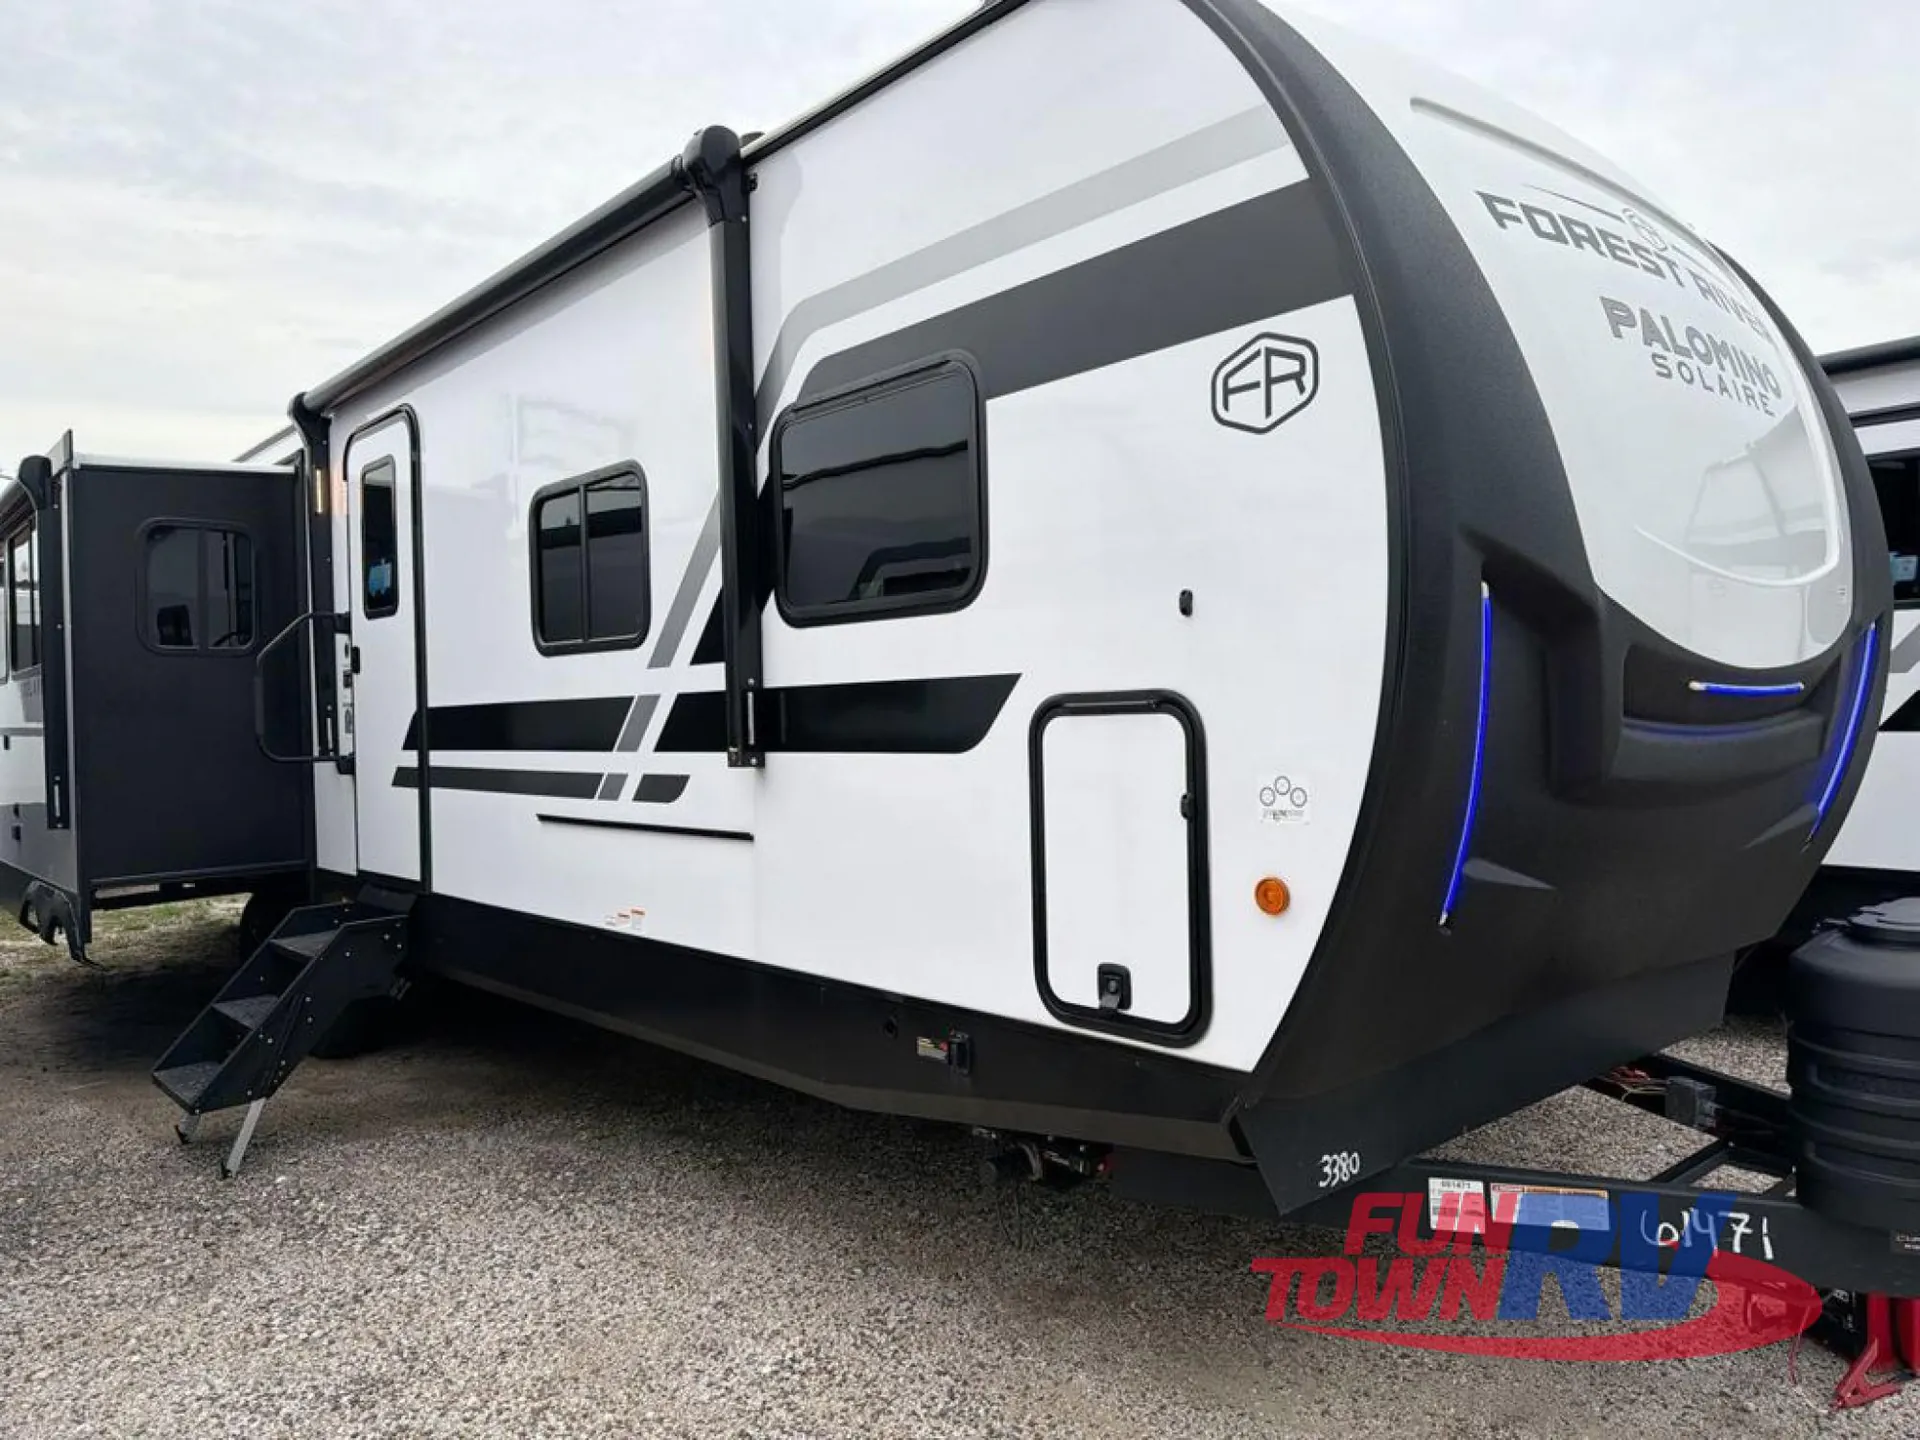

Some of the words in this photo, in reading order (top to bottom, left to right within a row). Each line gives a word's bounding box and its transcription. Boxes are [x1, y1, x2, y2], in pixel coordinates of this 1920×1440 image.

[1475, 190, 1685, 287] FOREST
[1600, 296, 1782, 399] PALOMINO
[1652, 353, 1776, 416] SOLAIRE
[1319, 1151, 1360, 1187] 3380
